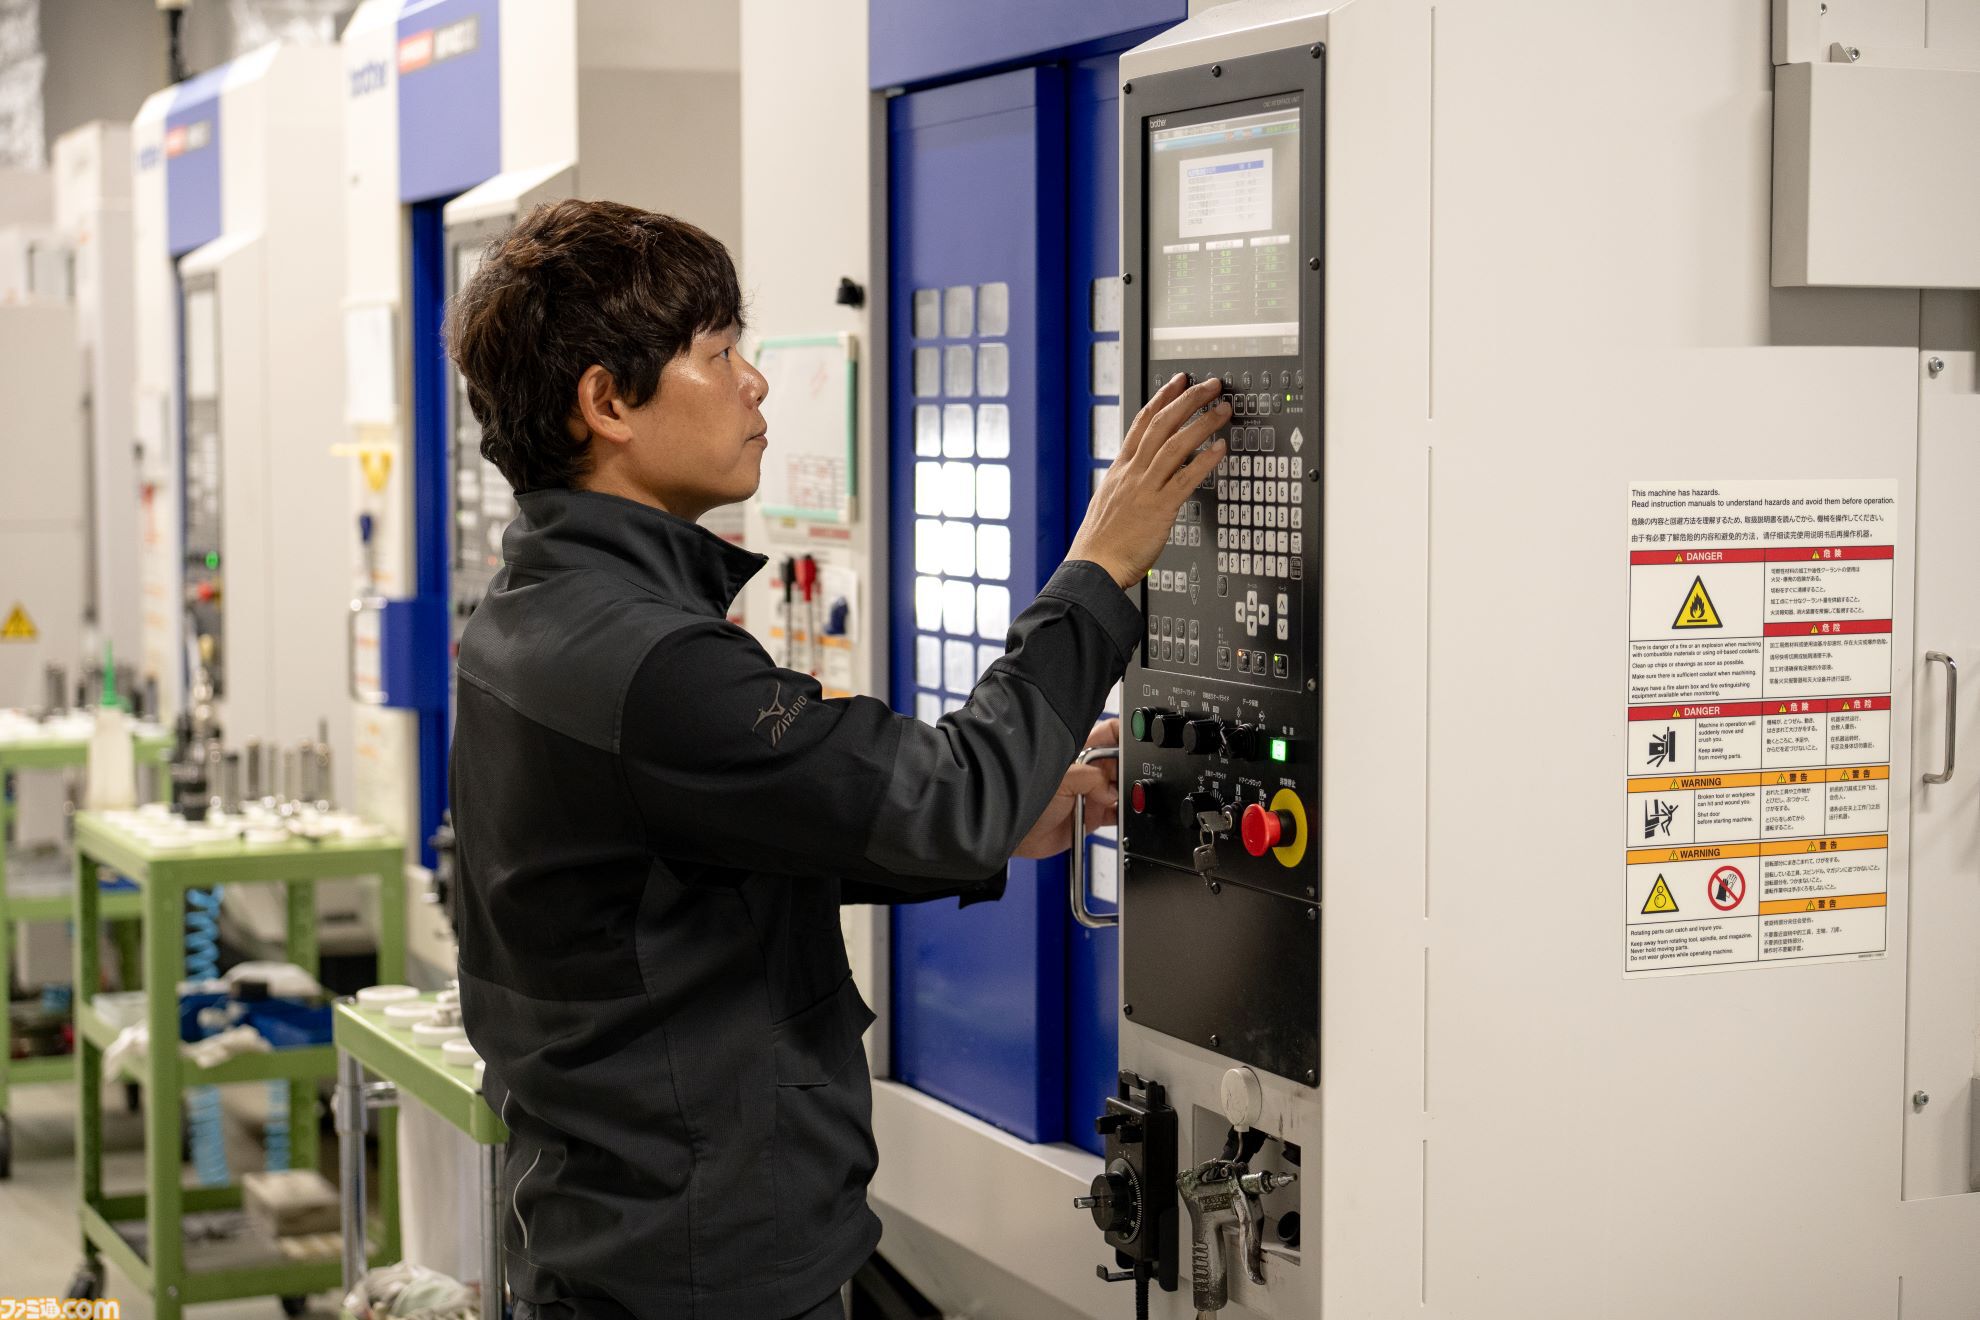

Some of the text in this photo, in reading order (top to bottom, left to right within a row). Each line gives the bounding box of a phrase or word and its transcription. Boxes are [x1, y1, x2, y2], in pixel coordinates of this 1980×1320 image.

[1150, 119, 1166, 129] brother
[1864, 497, 1894, 506] operation.
[1686, 552, 1723, 560] DANGER
[1684, 707, 1720, 716] DANGER
[1681, 778, 1721, 787] WARNING
[1680, 849, 1720, 858] WARNING
